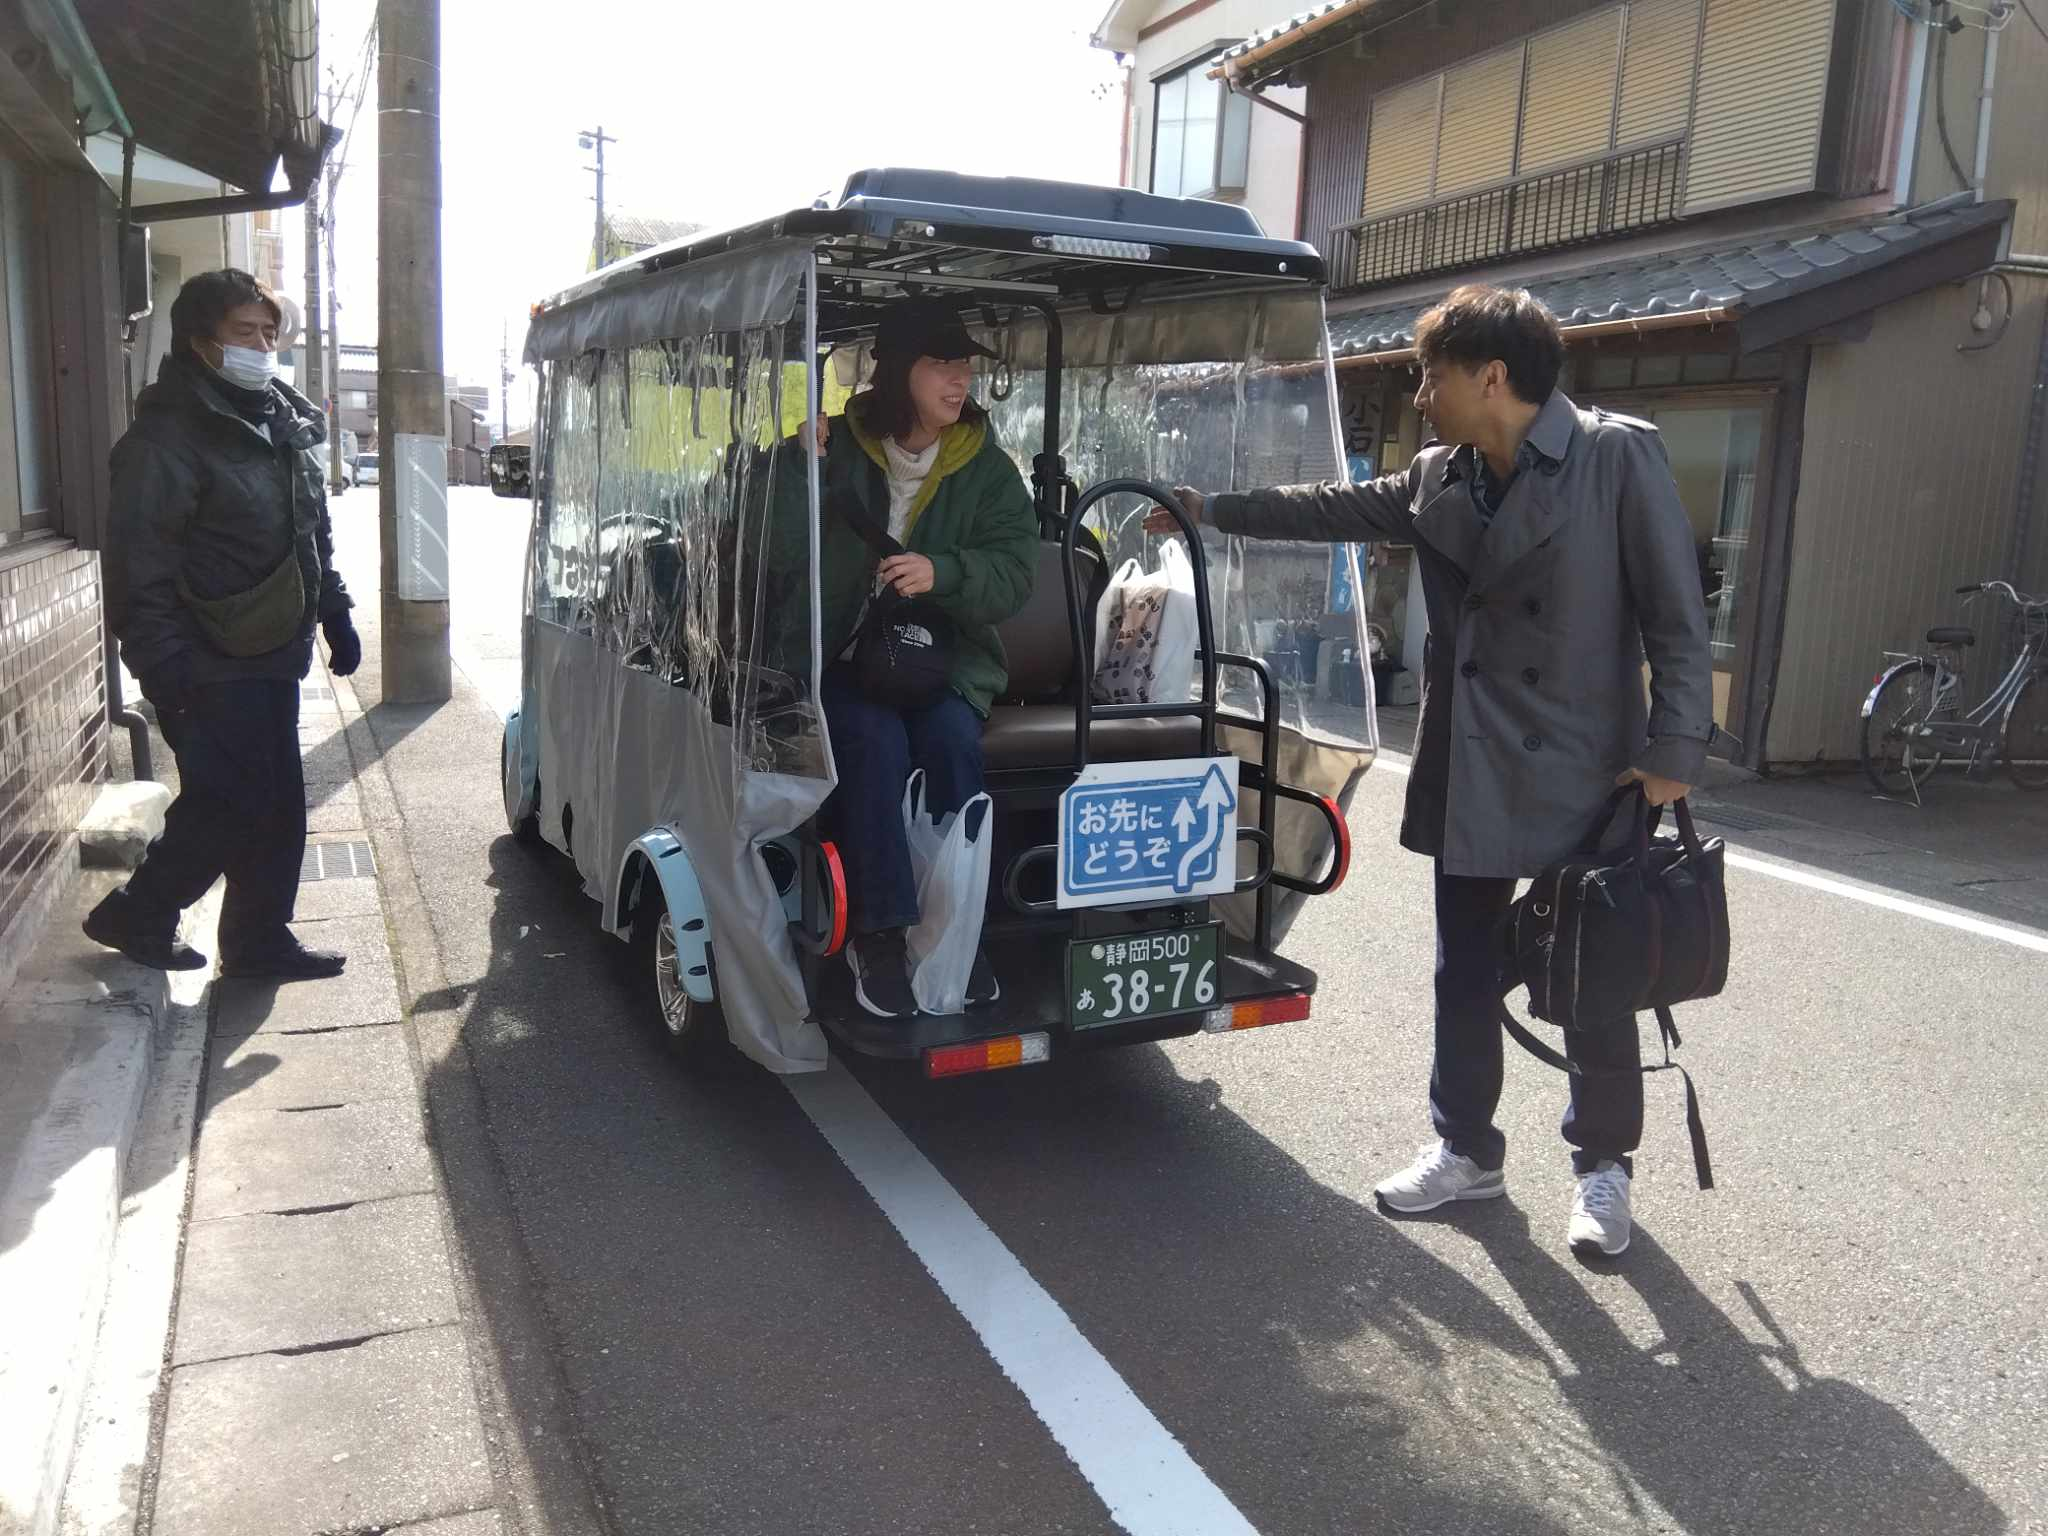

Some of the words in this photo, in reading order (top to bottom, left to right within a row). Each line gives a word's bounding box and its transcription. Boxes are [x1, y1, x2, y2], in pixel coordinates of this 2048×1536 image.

[1078, 799, 1162, 835] お先に
[1084, 838, 1172, 875] どうぞ
[1077, 989, 1095, 1010] あ
[1103, 960, 1215, 1017] 38-76
